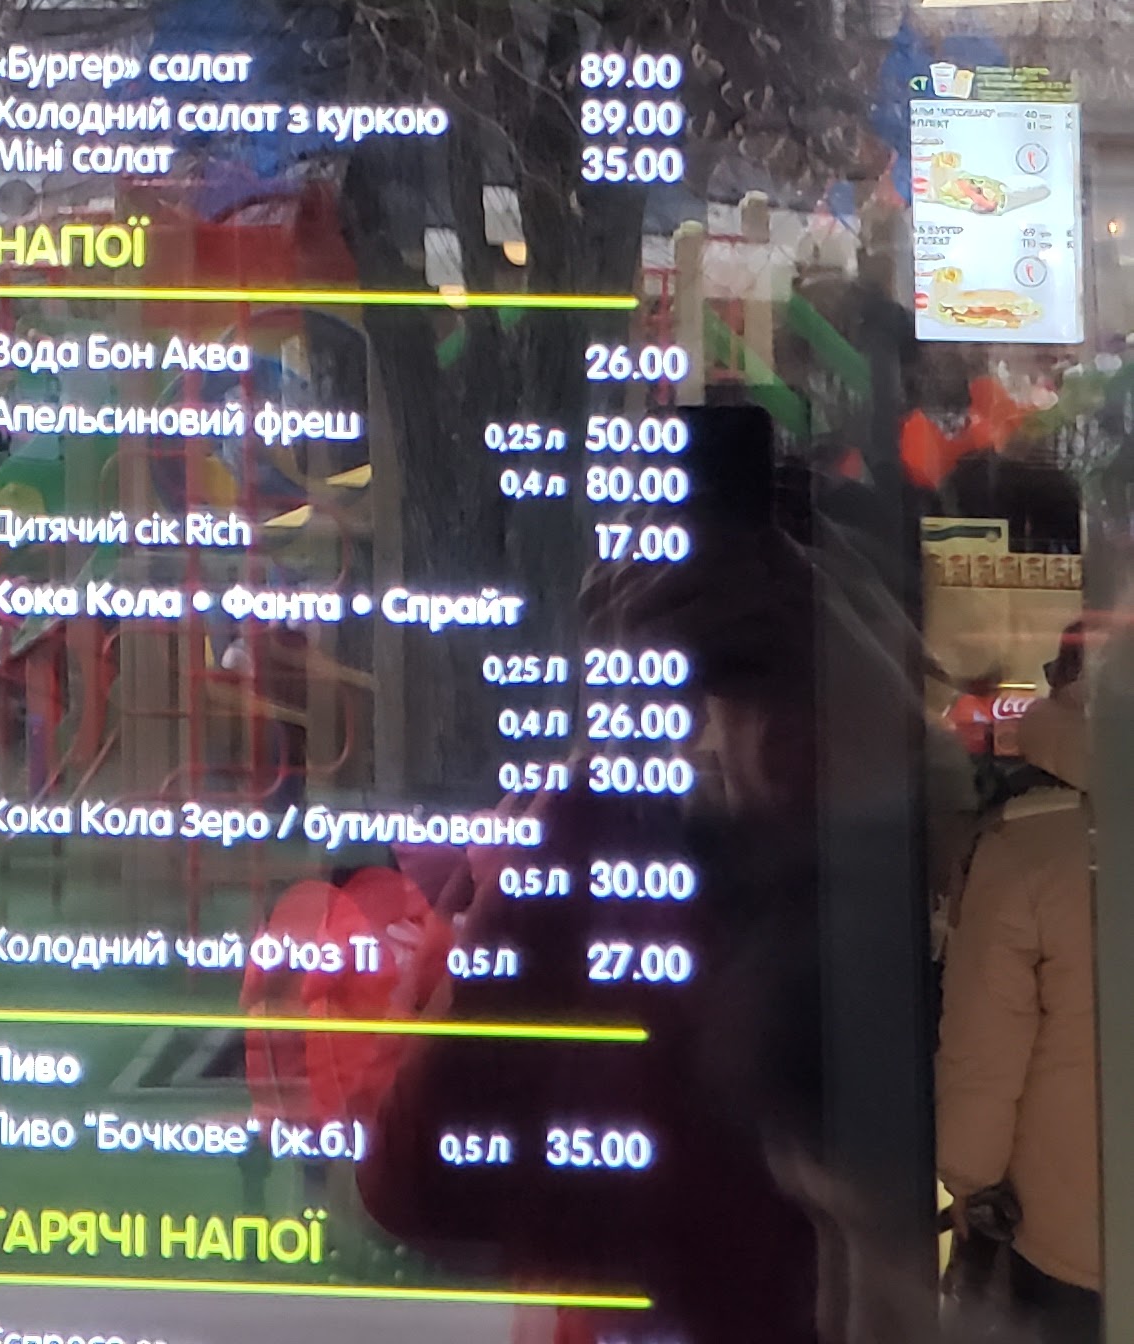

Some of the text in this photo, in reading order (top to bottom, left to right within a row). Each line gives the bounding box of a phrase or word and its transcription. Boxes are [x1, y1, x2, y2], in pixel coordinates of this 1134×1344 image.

[150, 53, 251, 81] салат
[580, 54, 682, 89] 89.00
[177, 106, 277, 133] салат
[318, 106, 448, 141] куркою
[580, 102, 684, 136] 89.00
[73, 143, 172, 173] салат
[580, 149, 684, 183] 35.00
[87, 335, 154, 370] Бон
[161, 338, 250, 373] Аква
[585, 346, 688, 381] 26.00
[255, 406, 360, 444] фреш
[485, 423, 542, 452] 0,25
[585, 418, 688, 452] 50.00
[500, 470, 542, 498] 0,4
[585, 467, 689, 502] 80.00
[135, 511, 180, 545] сік
[185, 520, 251, 546] Rich
[594, 526, 690, 561] 17.00
[86, 583, 182, 618] Кола
[222, 584, 342, 623] Фанта
[381, 584, 524, 630] Спрайт
[482, 656, 540, 686] 0,25
[585, 651, 689, 685] 20.00
[499, 710, 541, 740] 0,4
[587, 704, 691, 739] 26.00
[499, 763, 542, 793] 0,5
[588, 758, 694, 793] 30.00
[80, 801, 172, 837] Кола
[180, 802, 268, 841] Зеро
[304, 806, 542, 850] бутильована
[500, 867, 542, 897] 0,5
[590, 862, 694, 900] 30.00
[176, 933, 244, 970] чай
[447, 947, 492, 977] 0,5
[587, 944, 692, 983] 27.00
[440, 1133, 484, 1163] 0,5
[546, 1132, 652, 1170] 35.00
[160, 1211, 326, 1264] НАПОЇ
